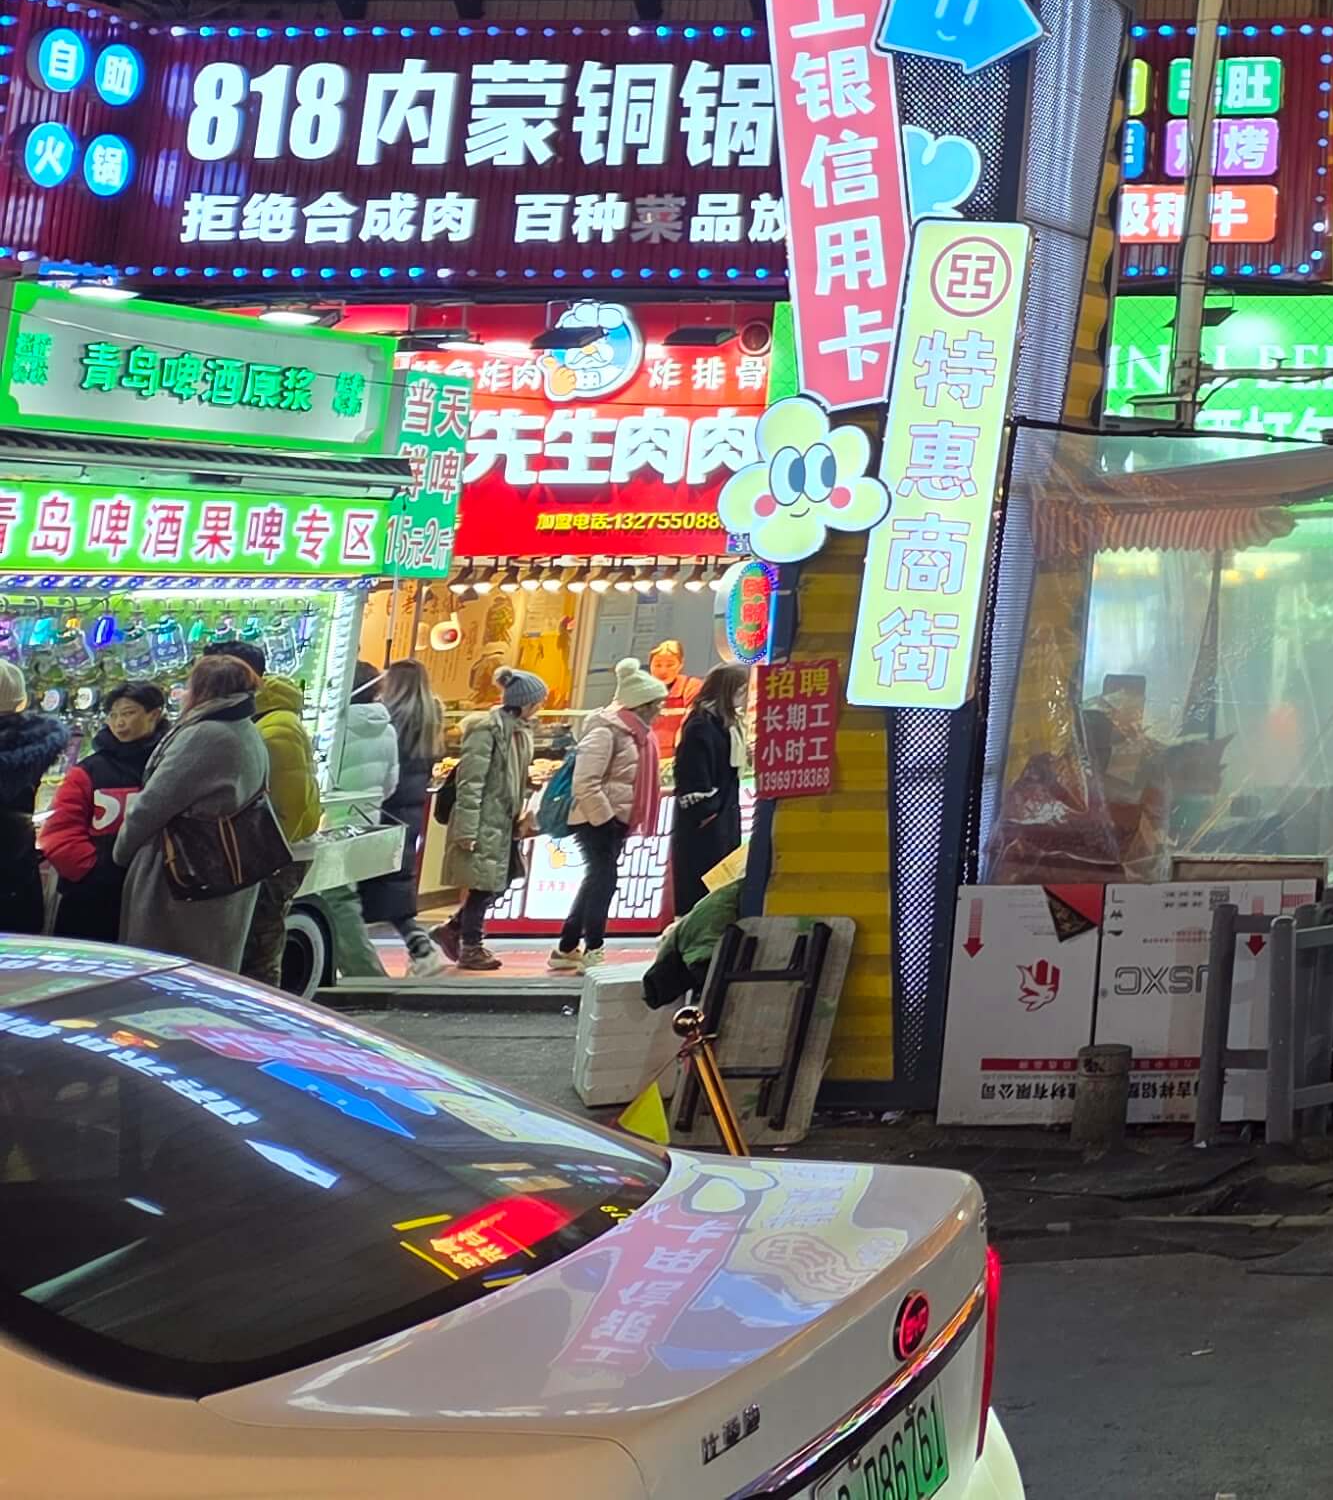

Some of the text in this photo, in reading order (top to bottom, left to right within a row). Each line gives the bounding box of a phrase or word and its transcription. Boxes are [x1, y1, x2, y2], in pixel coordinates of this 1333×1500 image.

[46, 39, 133, 94] 自助
[186, 58, 777, 168] 818内蒙铜锅
[33, 138, 127, 185] 火锅
[180, 192, 477, 244] 拒绝合成肉
[79, 341, 318, 413] 青岛啤酒原浆
[648, 357, 767, 390] 炸排骨
[402, 379, 470, 439] 当天
[536, 512, 725, 531] 加盟电话:132755088
[871, 329, 997, 690] 特惠商街
[766, 668, 830, 700] 招聘
[762, 704, 831, 733] 长期工
[761, 737, 829, 767] 小时工
[837, 1395, 943, 1499] D86761
